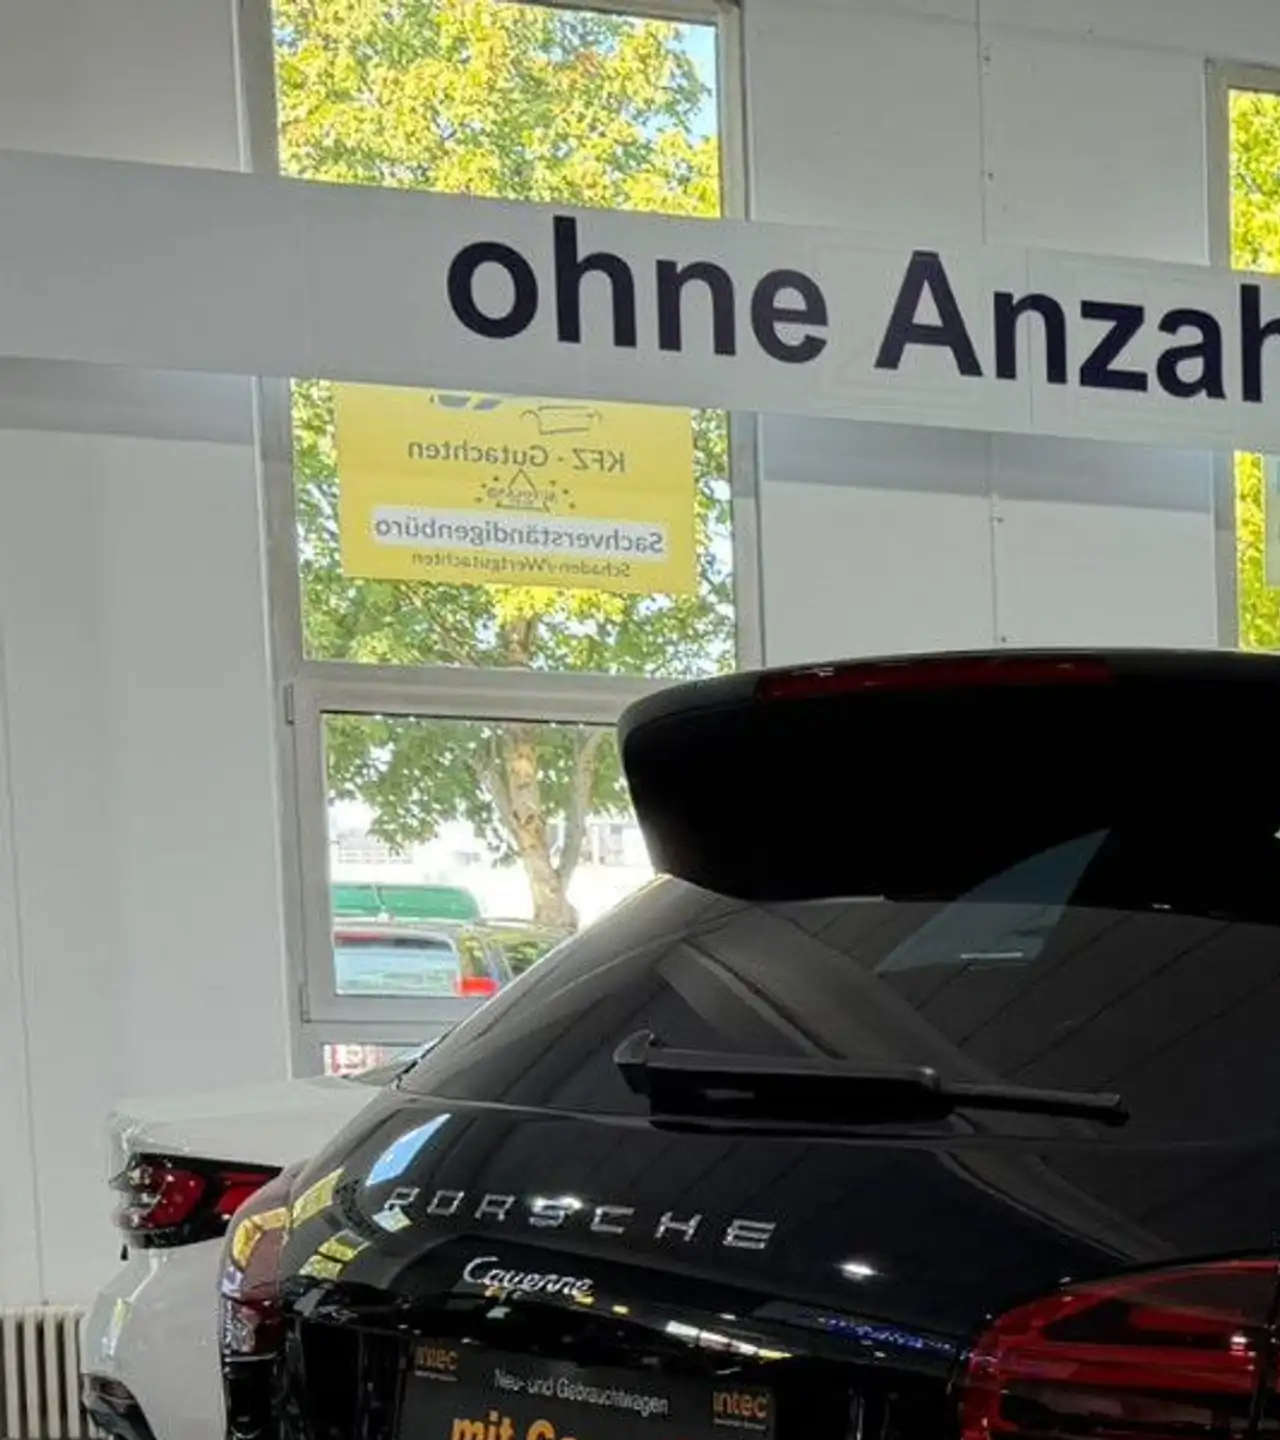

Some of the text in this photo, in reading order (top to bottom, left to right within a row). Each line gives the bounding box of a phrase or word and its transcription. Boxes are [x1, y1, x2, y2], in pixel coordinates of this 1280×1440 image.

[447, 215, 829, 363] ohne
[383, 1187, 777, 1251] PORSCHE
[463, 1256, 595, 1298] Cayenne
[556, 1377, 670, 1417] Gebrauchtwagen
